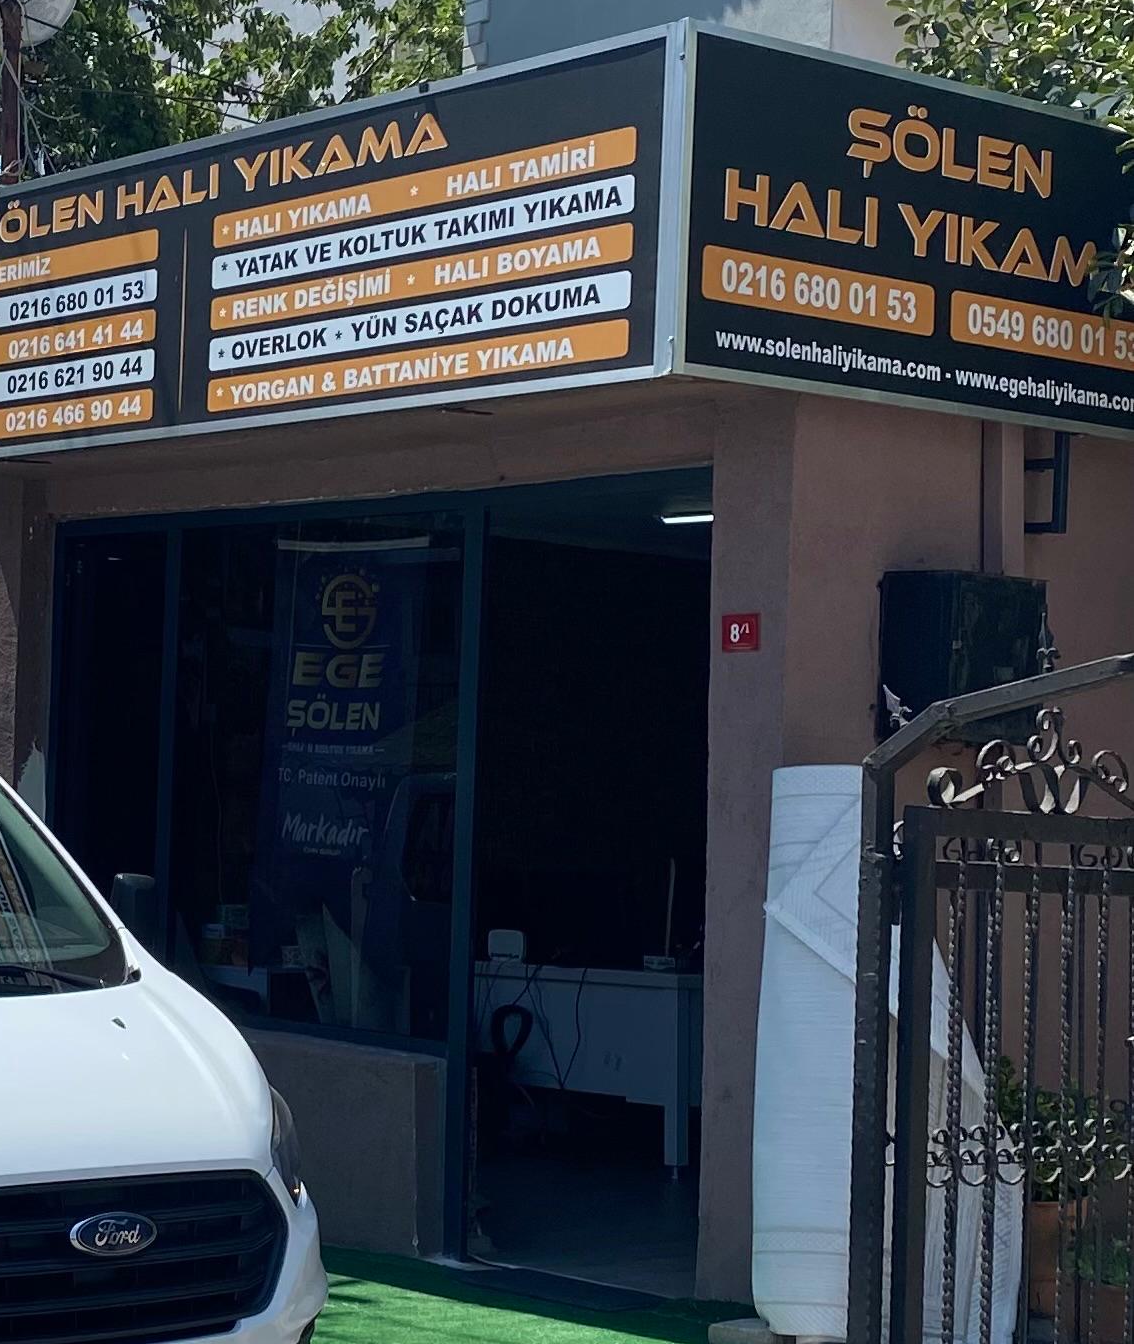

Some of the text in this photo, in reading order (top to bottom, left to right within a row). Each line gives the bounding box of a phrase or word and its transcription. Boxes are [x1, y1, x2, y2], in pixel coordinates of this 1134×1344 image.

[116, 163, 219, 220] HALI
[234, 113, 449, 192] YIKAMA
[846, 104, 1053, 199] ŞÖLEN
[234, 140, 595, 241] HALI YIKAMA HALI TAMİRİ
[235, 185, 622, 278] YATAK VE KOLTUK TAKIMI YIKAMA
[723, 167, 1098, 287] HALI YIKAM
[9, 297, 51, 321] 0216
[55, 291, 88, 313] 680
[94, 285, 114, 306] 01
[122, 279, 144, 302] 53
[232, 236, 601, 320] RENK DEĞİŞİMİ HALI BOYAMA
[721, 258, 917, 323] 0216 680 01 53
[8, 336, 50, 360] 0216
[54, 328, 85, 350] 641
[92, 324, 113, 345] 41
[120, 319, 144, 340] 44
[231, 283, 601, 360] OVERLOK YÜN SAÇAK DOKUMA
[968, 303, 1025, 342] 0549
[1032, 314, 1073, 351] 680
[1080, 324, 1106, 356] 01
[7, 371, 48, 394] 0216
[54, 366, 85, 387] 621
[91, 360, 114, 382] 90
[119, 355, 143, 377] 44
[230, 338, 575, 405] YORGAN & BATTANİYE YIKAMA
[715, 330, 941, 382] www.solenhaliyikama.com
[955, 369, 1134, 413] www.egehaliyikama.co
[5, 409, 47, 432] 0216
[52, 403, 85, 425] 466
[90, 399, 113, 421] 90
[118, 395, 142, 417] 44
[292, 651, 386, 689] EGE
[286, 693, 381, 737] ŞÖLEN
[298, 768, 338, 787] Patent
[94, 1218, 142, 1246] Ford
